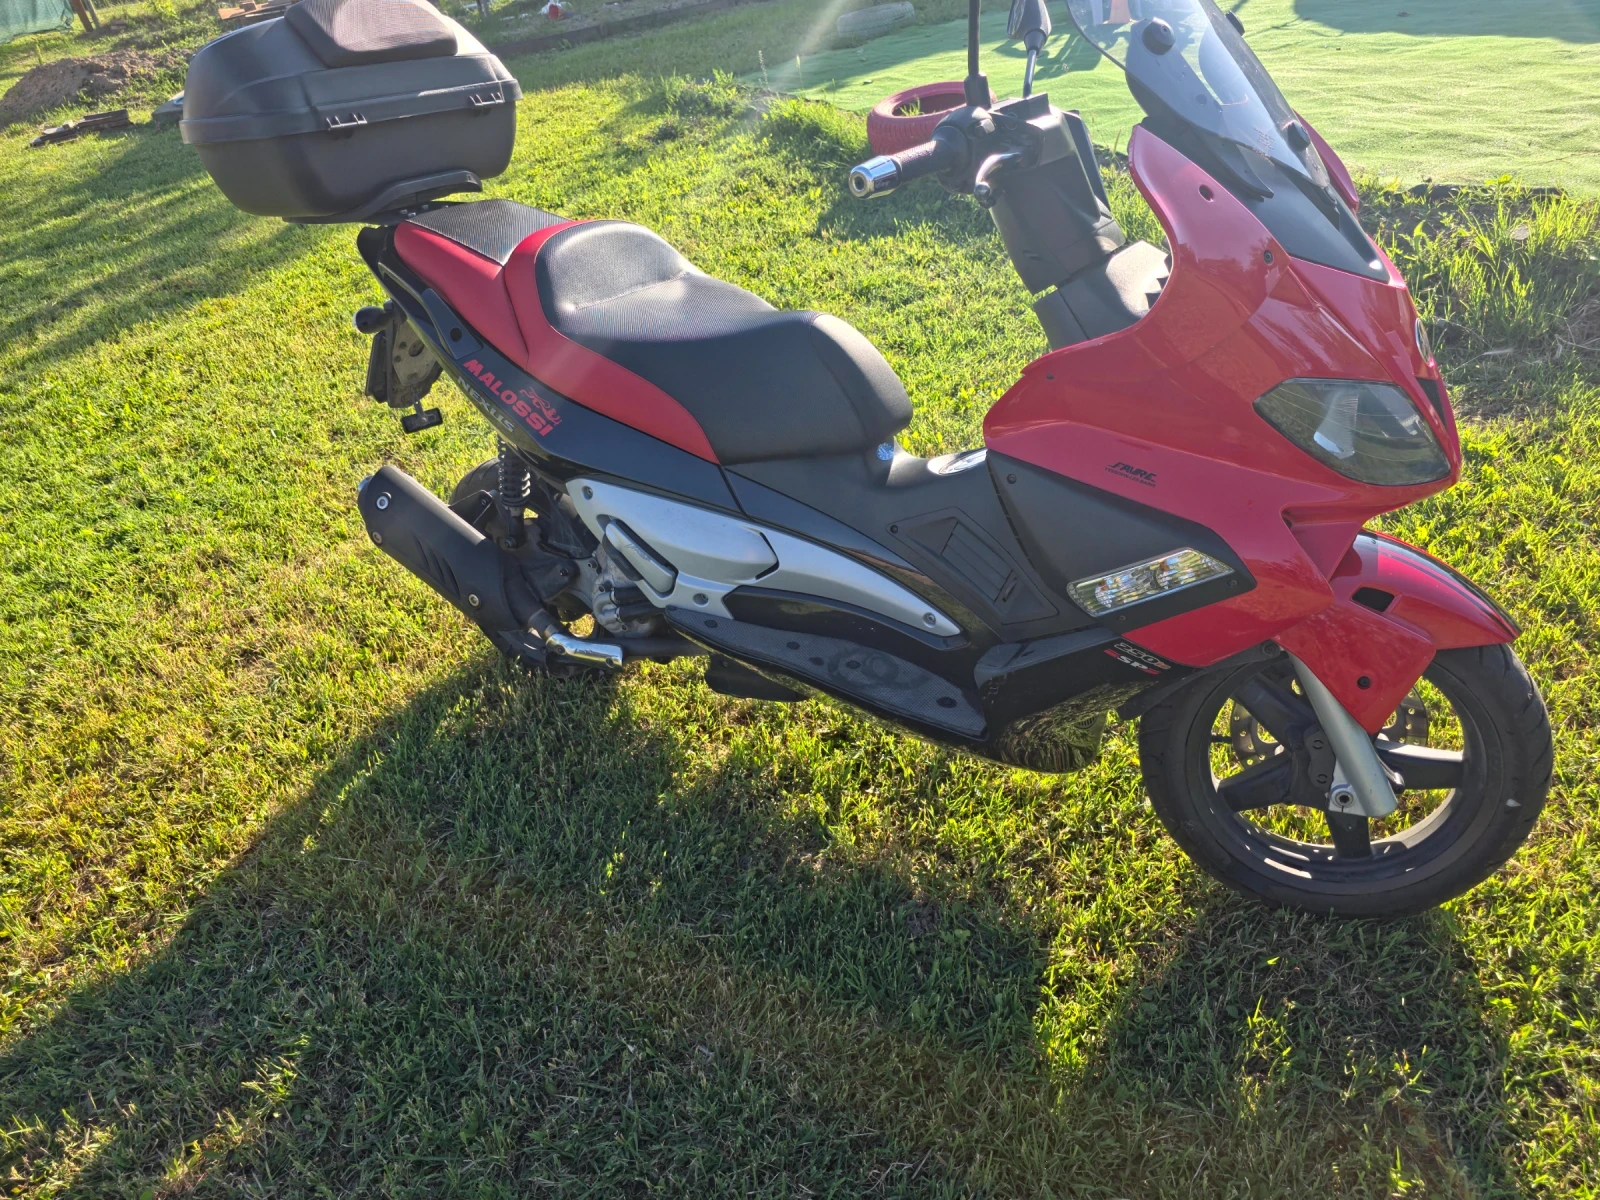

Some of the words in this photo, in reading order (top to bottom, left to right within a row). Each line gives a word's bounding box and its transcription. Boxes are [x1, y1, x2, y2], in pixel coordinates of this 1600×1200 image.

[457, 376, 515, 433] NEXUS
[463, 359, 553, 437] MALOSSI
[1117, 655, 1149, 670] SP
